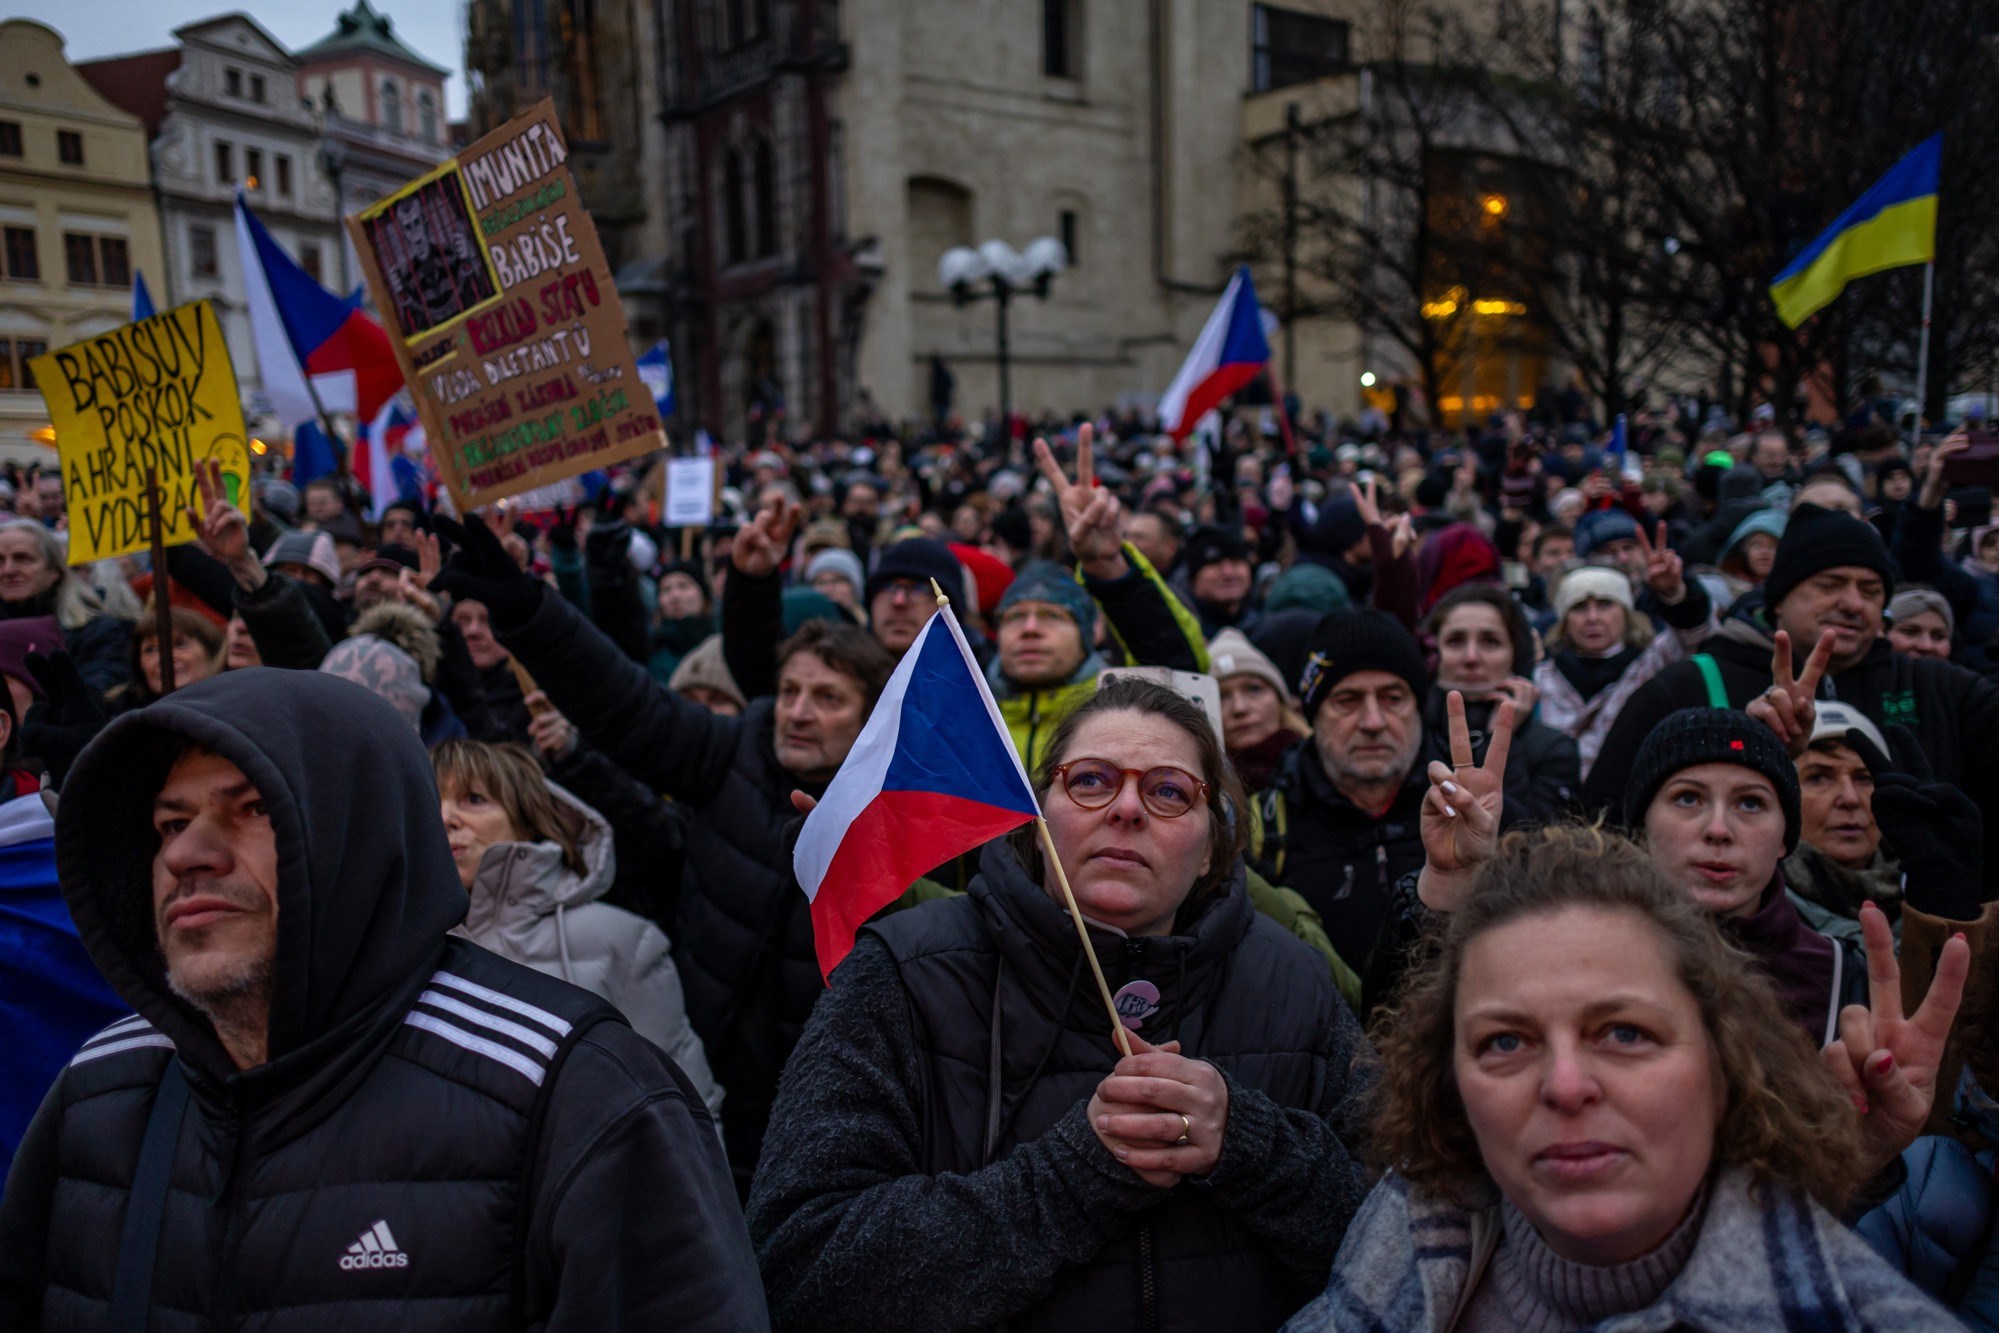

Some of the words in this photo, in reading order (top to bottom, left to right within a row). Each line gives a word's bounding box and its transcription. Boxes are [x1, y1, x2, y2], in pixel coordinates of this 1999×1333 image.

[462, 119, 568, 211] IMUNITA
[483, 321, 591, 386] DILETANTŮ
[98, 374, 214, 450] POSKOK
[340, 1250, 409, 1270] adidas
